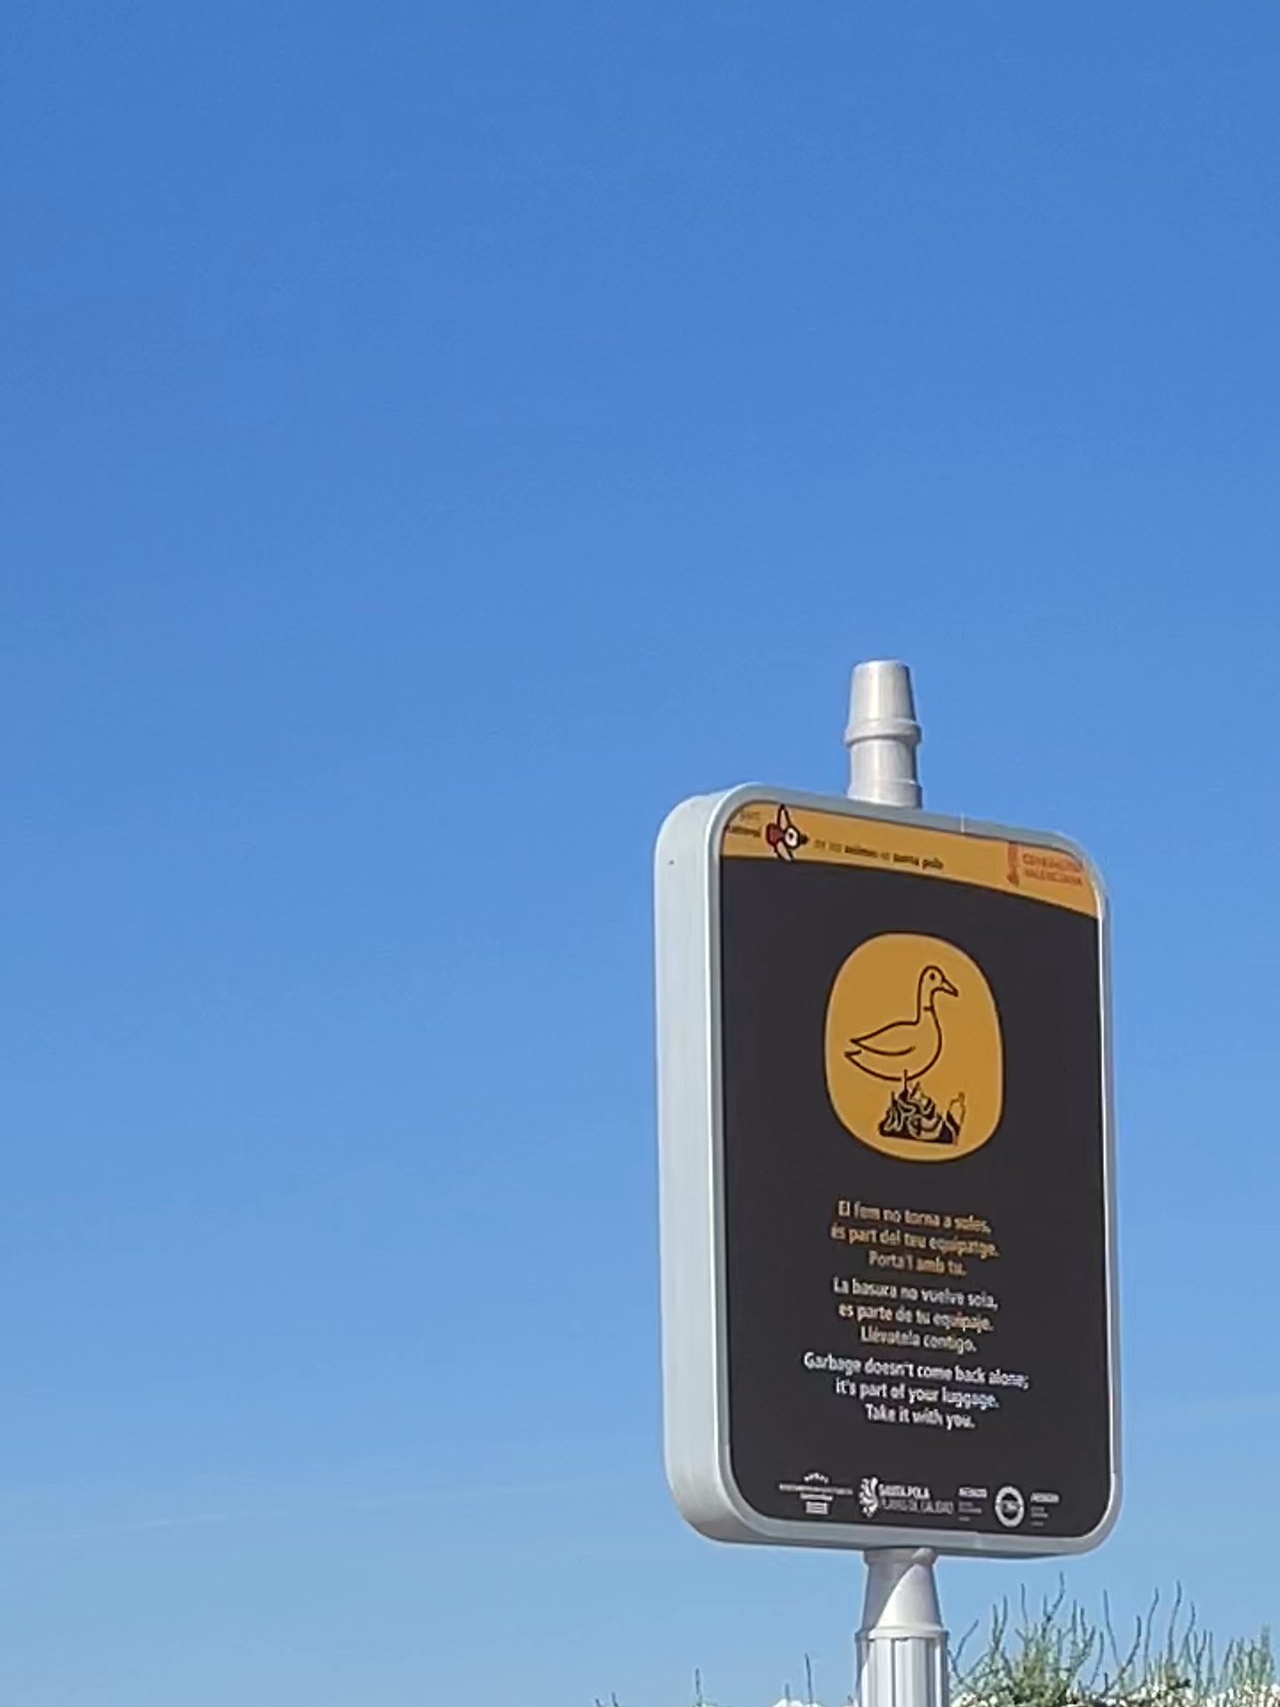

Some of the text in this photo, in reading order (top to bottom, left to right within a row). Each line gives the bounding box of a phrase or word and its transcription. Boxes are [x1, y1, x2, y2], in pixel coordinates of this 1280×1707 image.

[838, 1201, 850, 1216] El
[883, 1210, 902, 1223] no
[905, 1210, 940, 1227] torna
[943, 1217, 951, 1228] a
[849, 1229, 876, 1244] part
[880, 1230, 900, 1245] del
[904, 1234, 926, 1248] teu
[916, 1256, 945, 1273] amb
[948, 1260, 967, 1276] tu.
[833, 1277, 998, 1311] La basura no vuelve sola,
[839, 1304, 854, 1317] es
[857, 1306, 892, 1321] parte
[896, 1305, 912, 1322] de
[916, 1309, 930, 1324] tu
[860, 1326, 976, 1354] Llévatela contigo.
[804, 1352, 861, 1376] Garbage
[864, 1358, 914, 1377] doesn't
[917, 1365, 952, 1381] come
[955, 1365, 985, 1384] back
[860, 1384, 887, 1400] part
[890, 1384, 905, 1398] of
[908, 1388, 939, 1404] your
[942, 1387, 999, 1410] luggage.
[865, 1403, 975, 1430] Take it with you.
